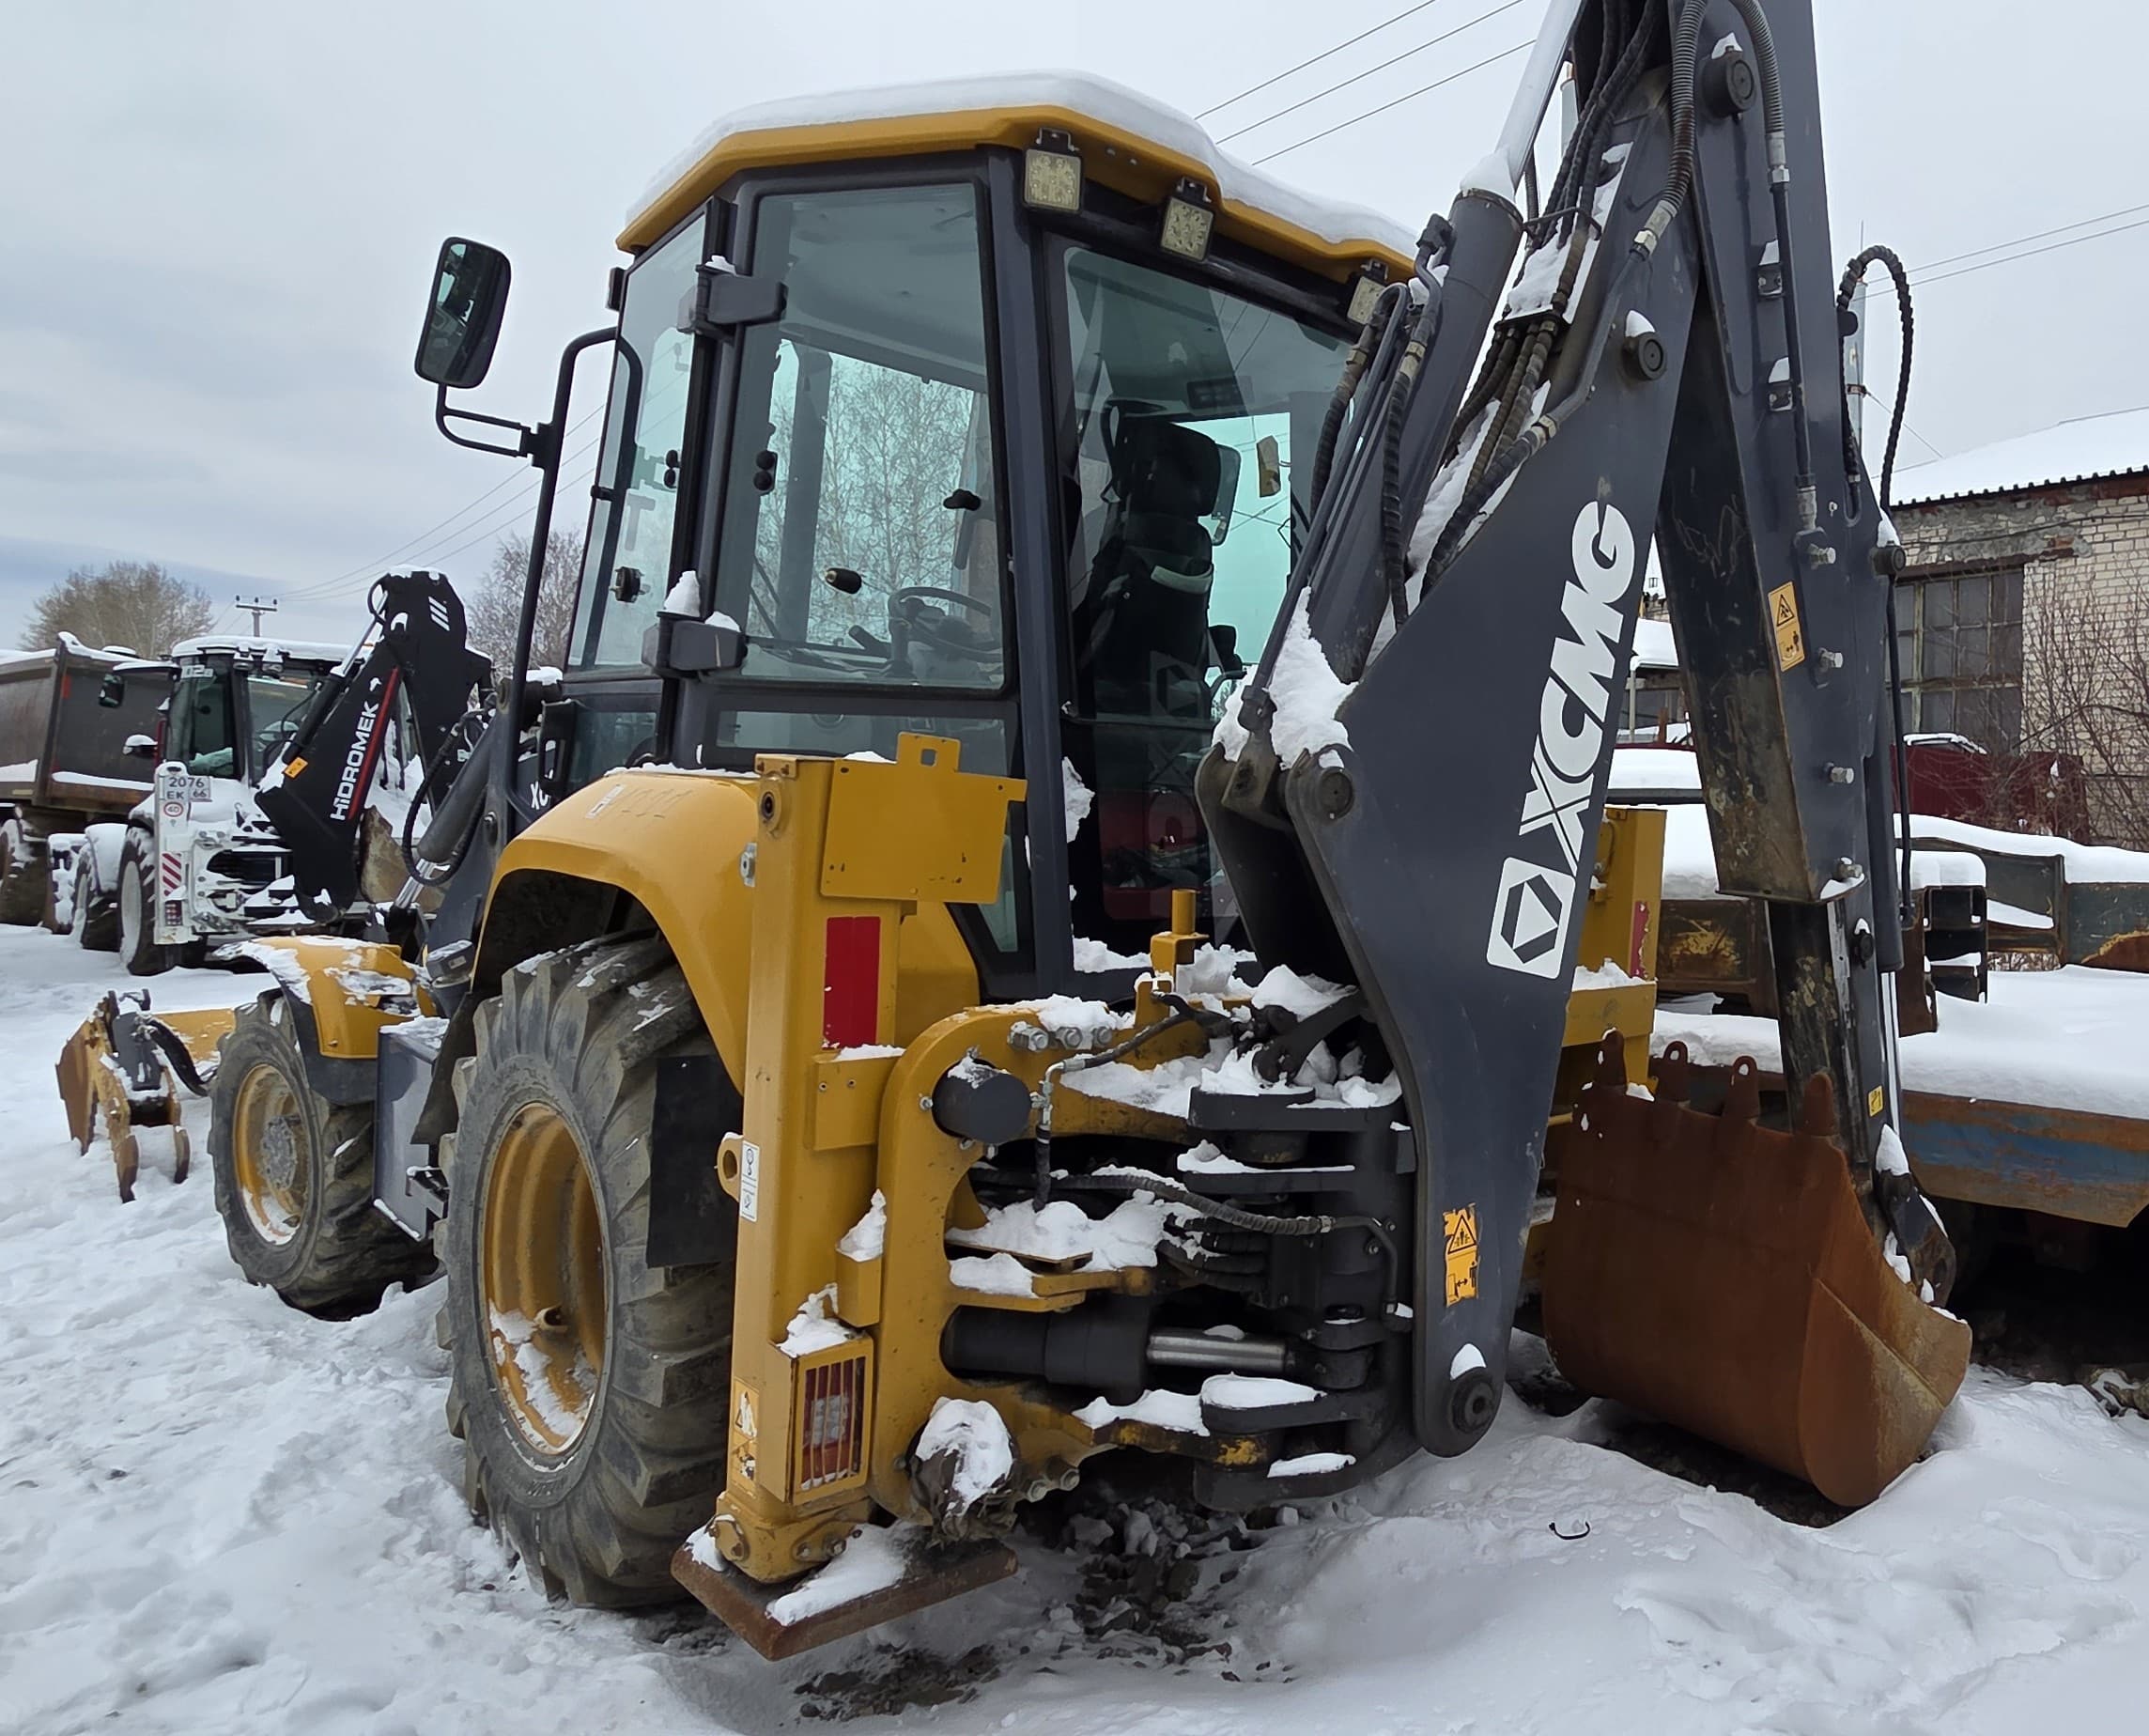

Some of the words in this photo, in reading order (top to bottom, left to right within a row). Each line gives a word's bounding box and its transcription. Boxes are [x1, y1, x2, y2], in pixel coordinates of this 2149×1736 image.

[1518, 501, 1635, 877] XCMG
[169, 777, 205, 787] 2076
[193, 789, 207, 798] 66
